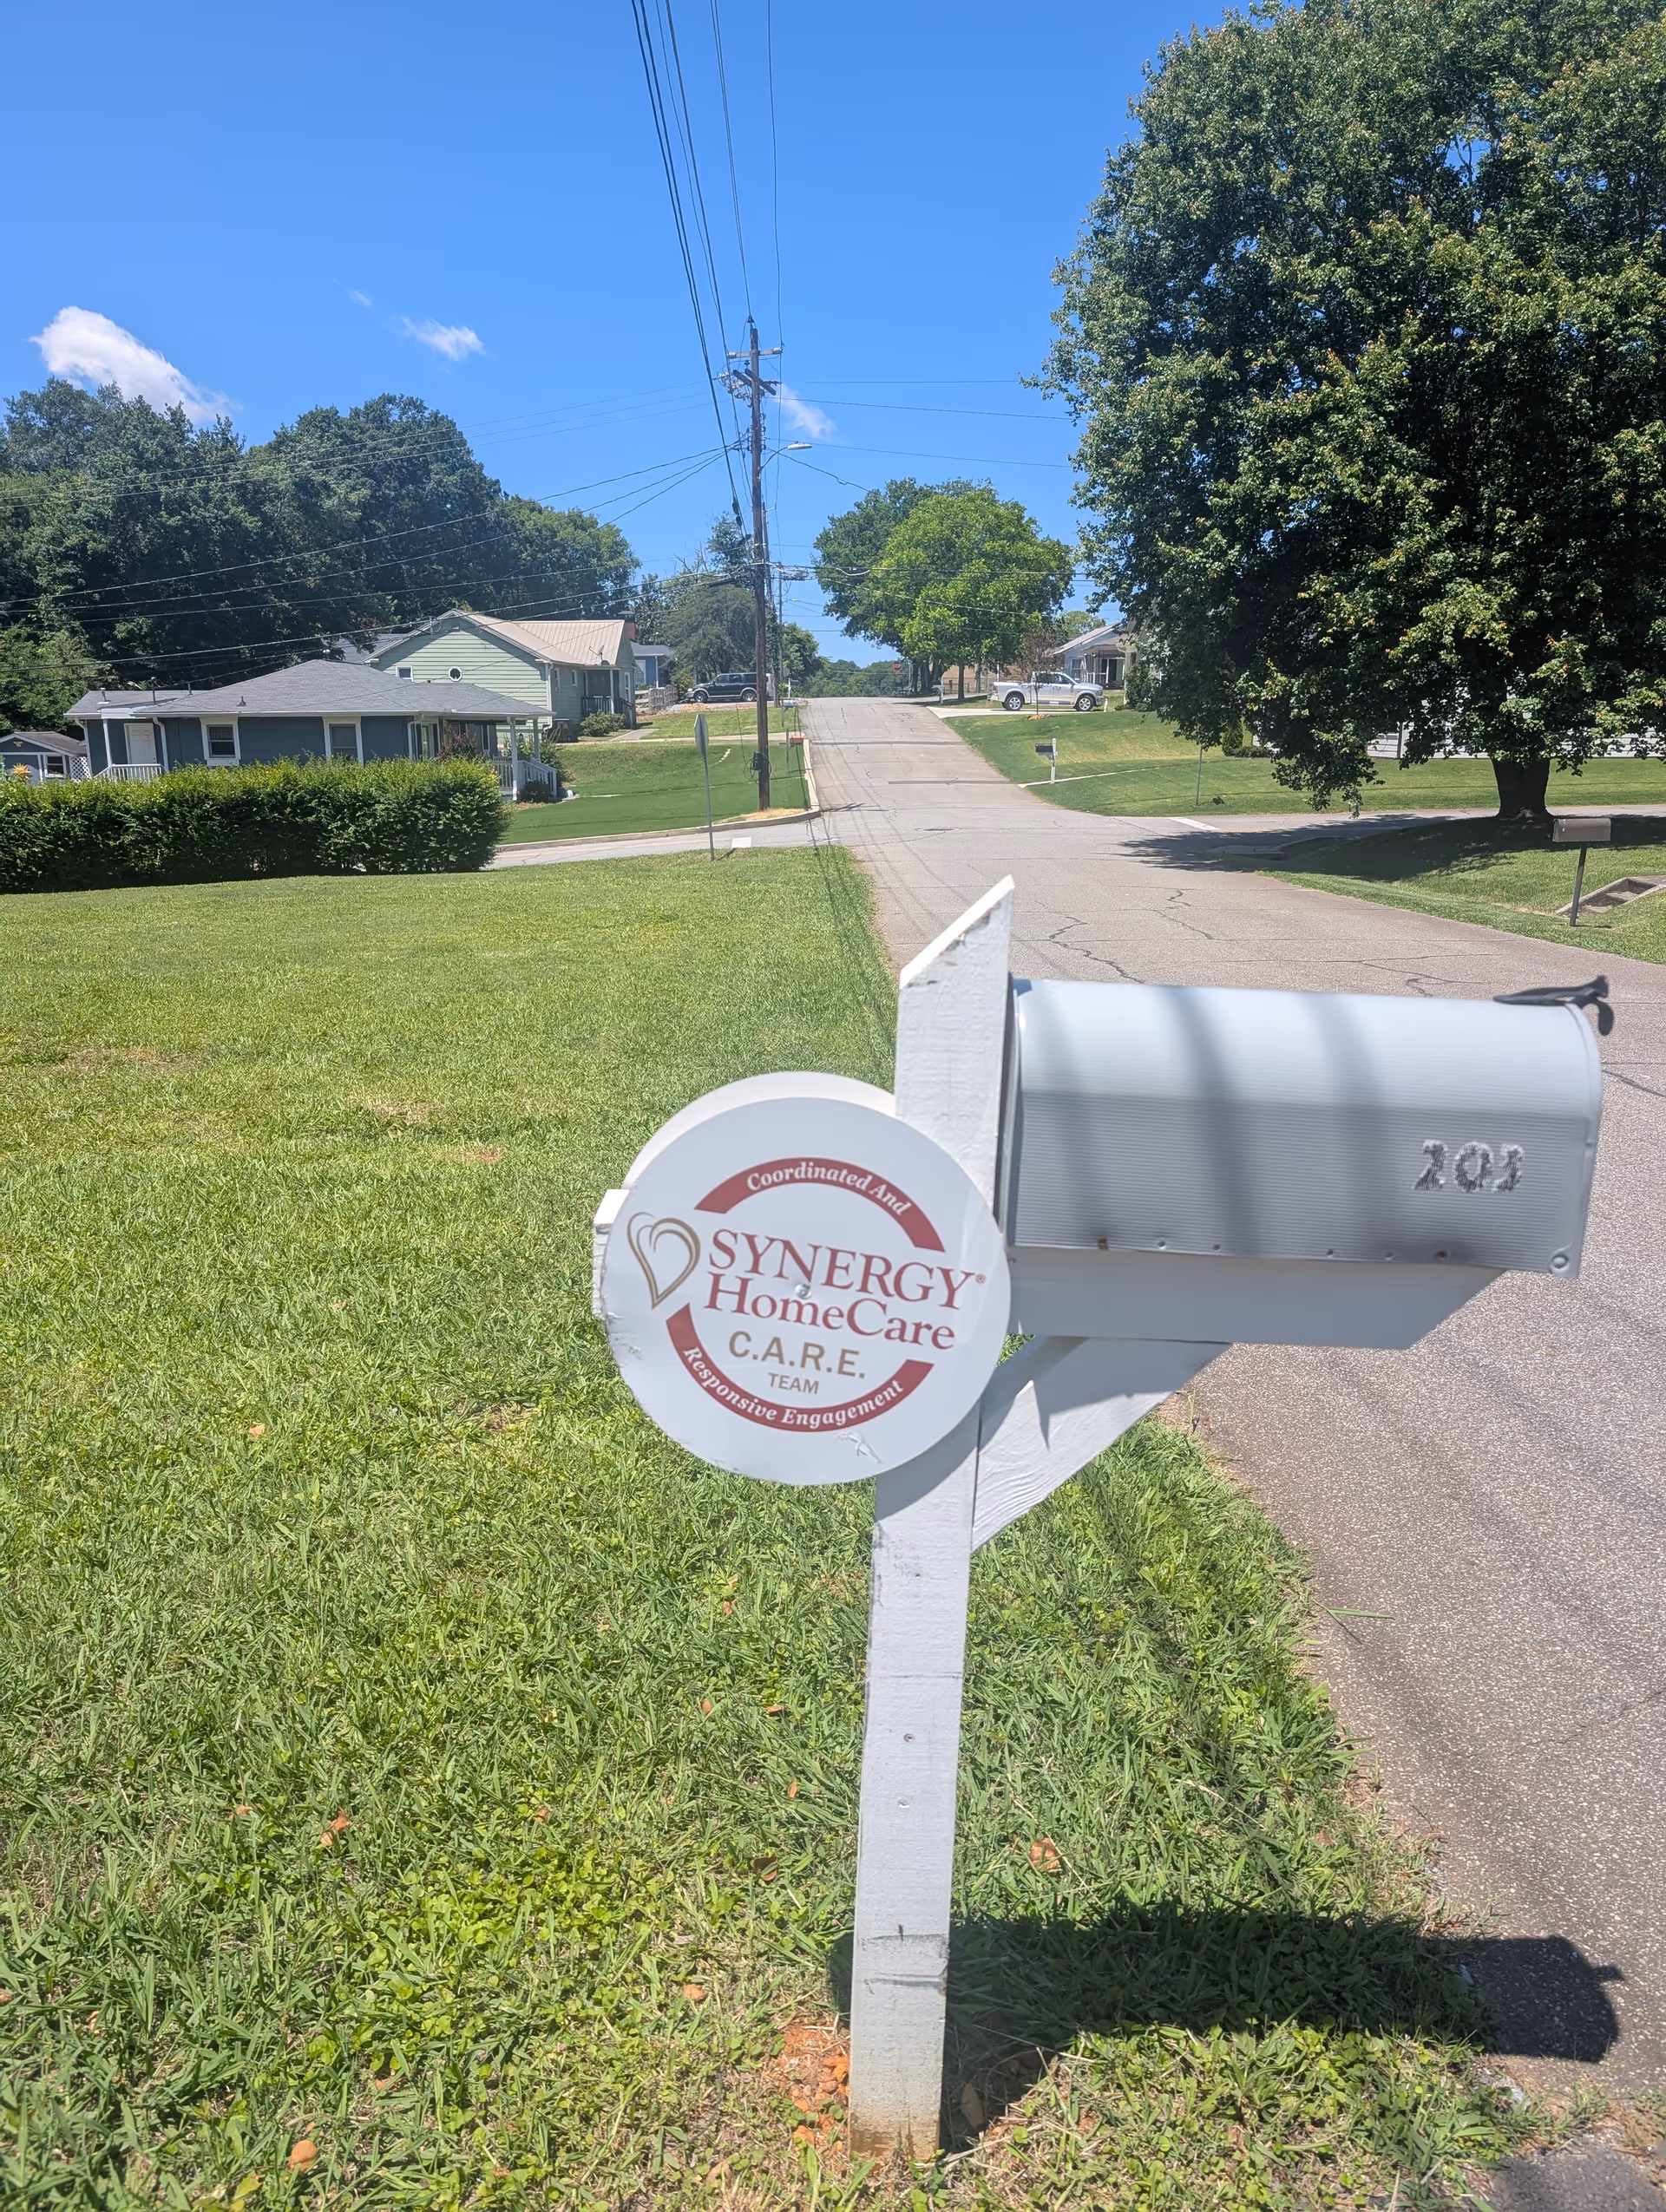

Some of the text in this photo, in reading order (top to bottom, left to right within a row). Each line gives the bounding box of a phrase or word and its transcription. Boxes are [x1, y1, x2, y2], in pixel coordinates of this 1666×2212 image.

[746, 1162, 912, 1215] Coordinated And
[703, 1271, 955, 1350] HomeCare
[728, 1331, 866, 1379] C.A.R.E.
[683, 1346, 903, 1430] Responsive Engagement
[768, 1372, 820, 1395] TEAM
